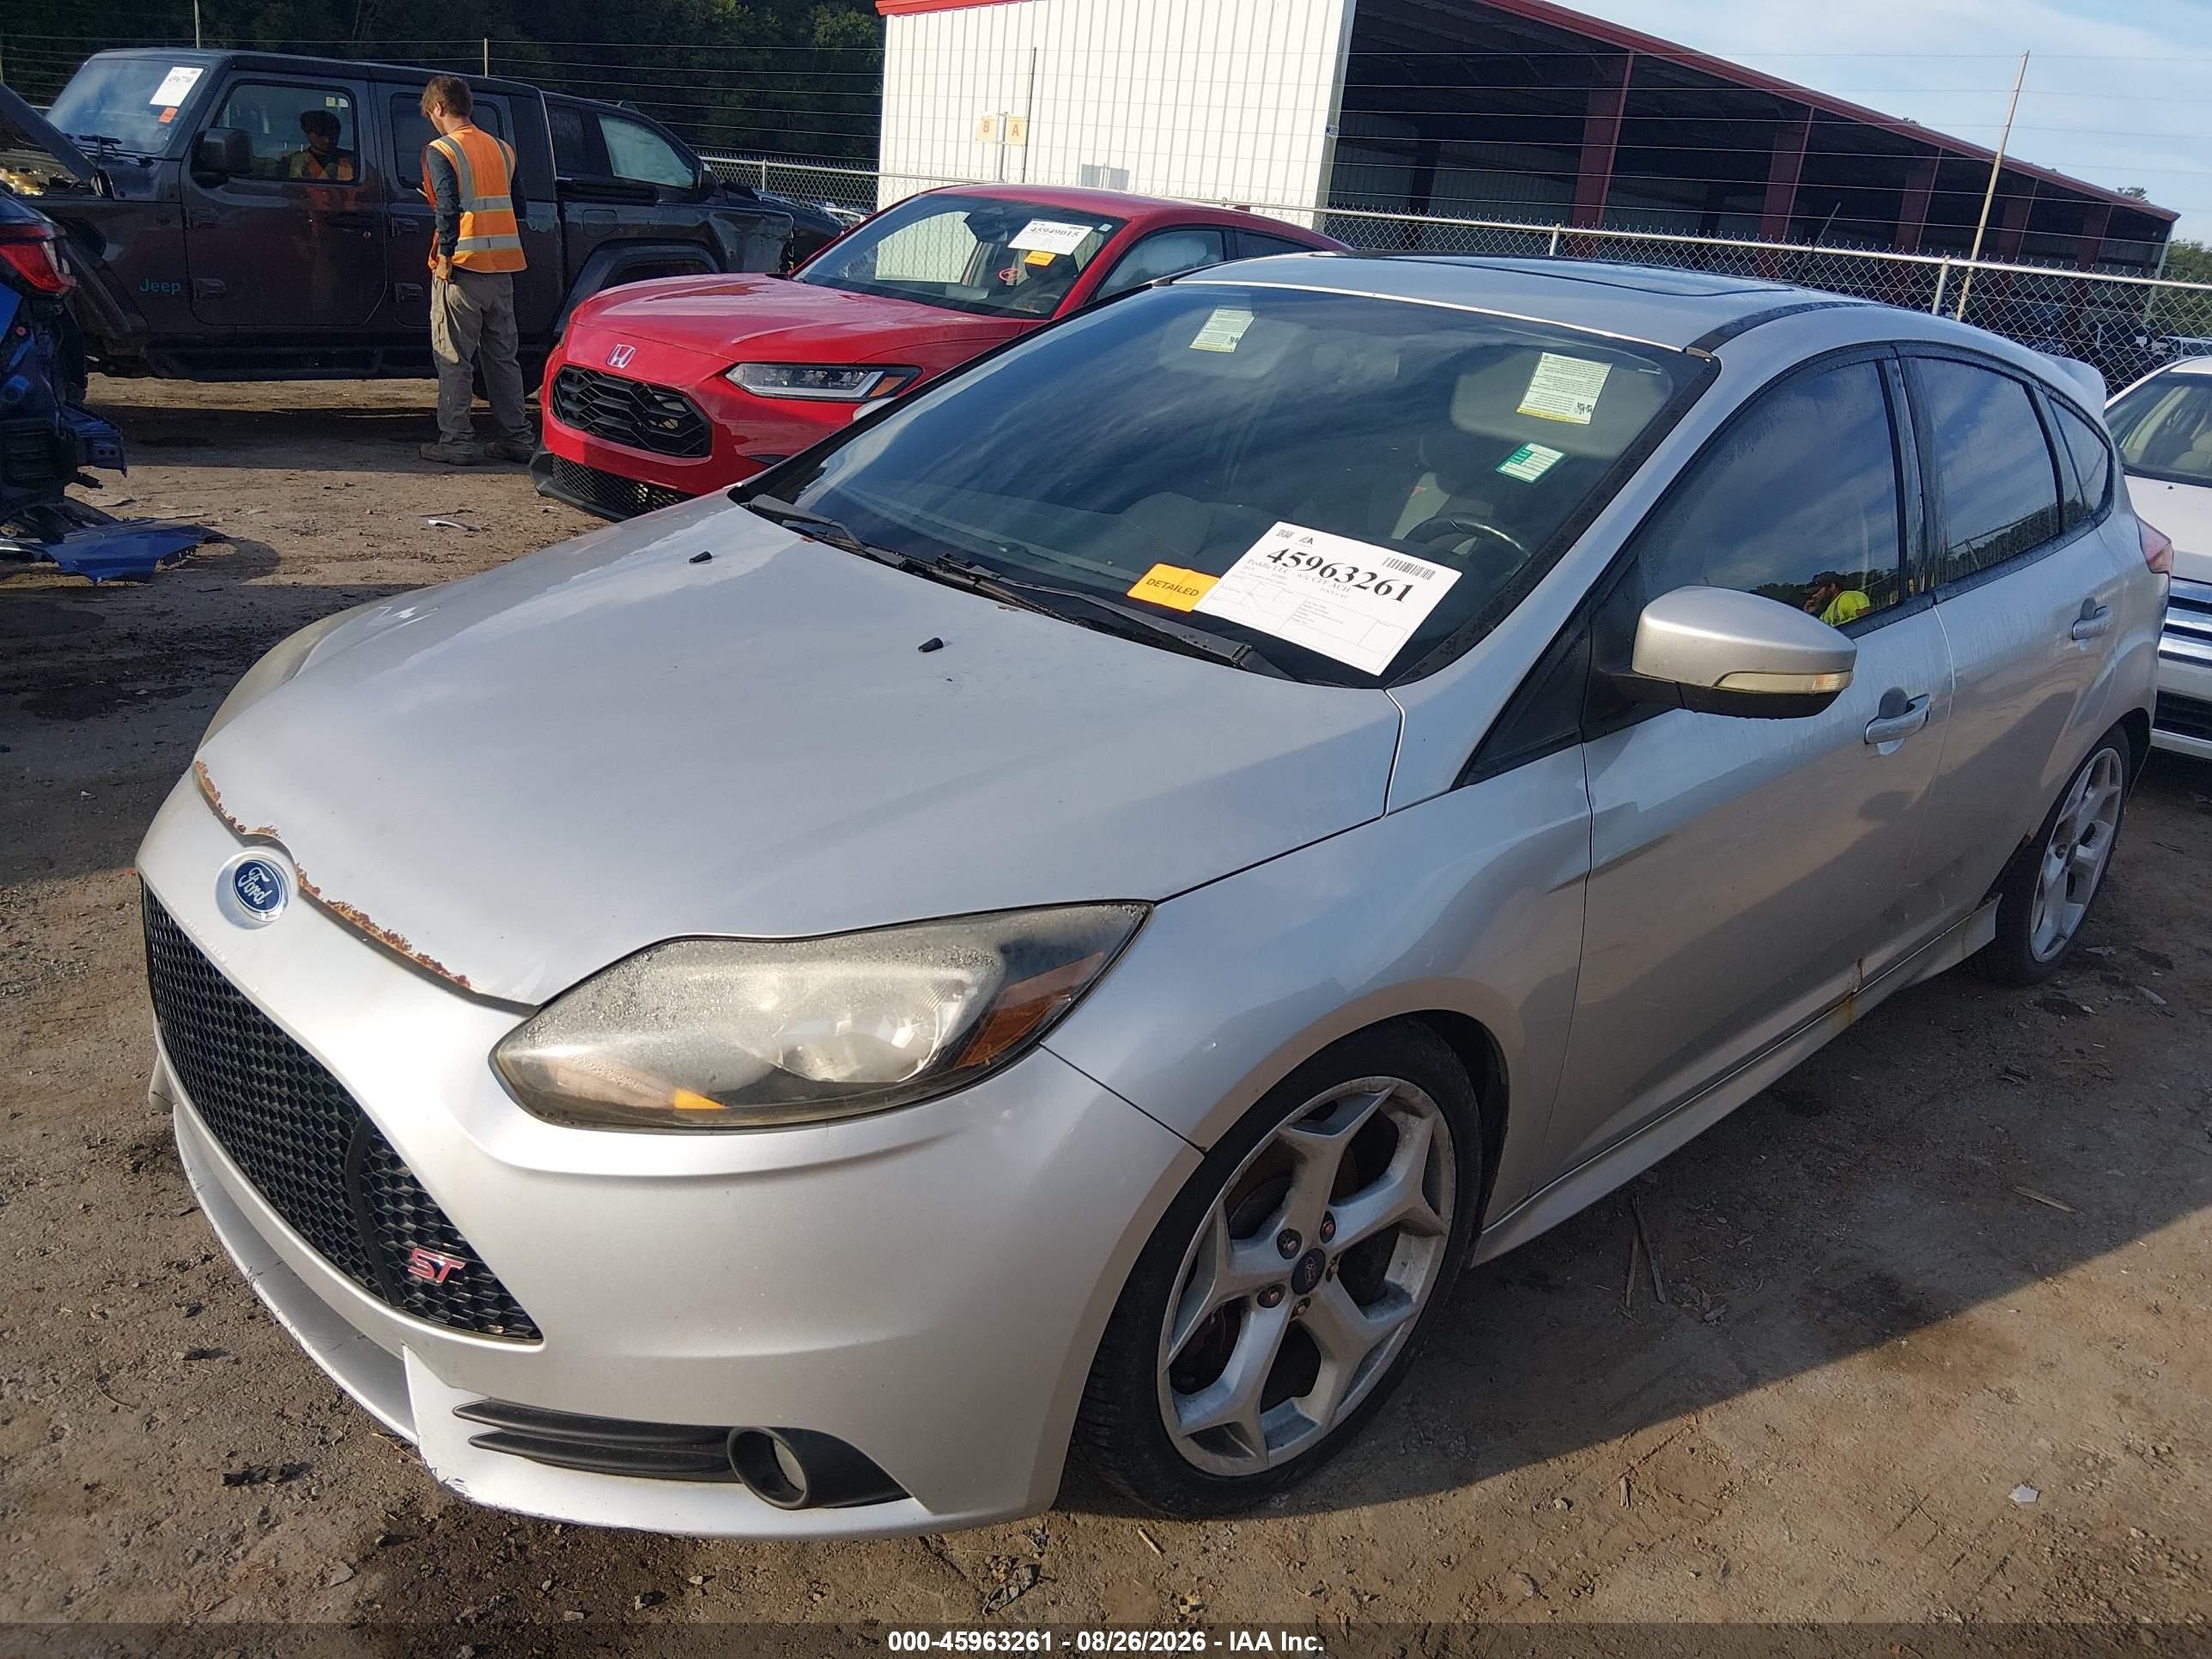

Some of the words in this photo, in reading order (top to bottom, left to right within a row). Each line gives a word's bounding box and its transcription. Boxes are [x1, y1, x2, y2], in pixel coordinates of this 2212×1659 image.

[1012, 124, 1019, 137] A
[139, 277, 180, 295] Jeep
[1146, 578, 1200, 597] DETAILED
[1267, 548, 1414, 603] 45963261
[238, 866, 273, 905] Ford
[408, 1248, 467, 1283] ST
